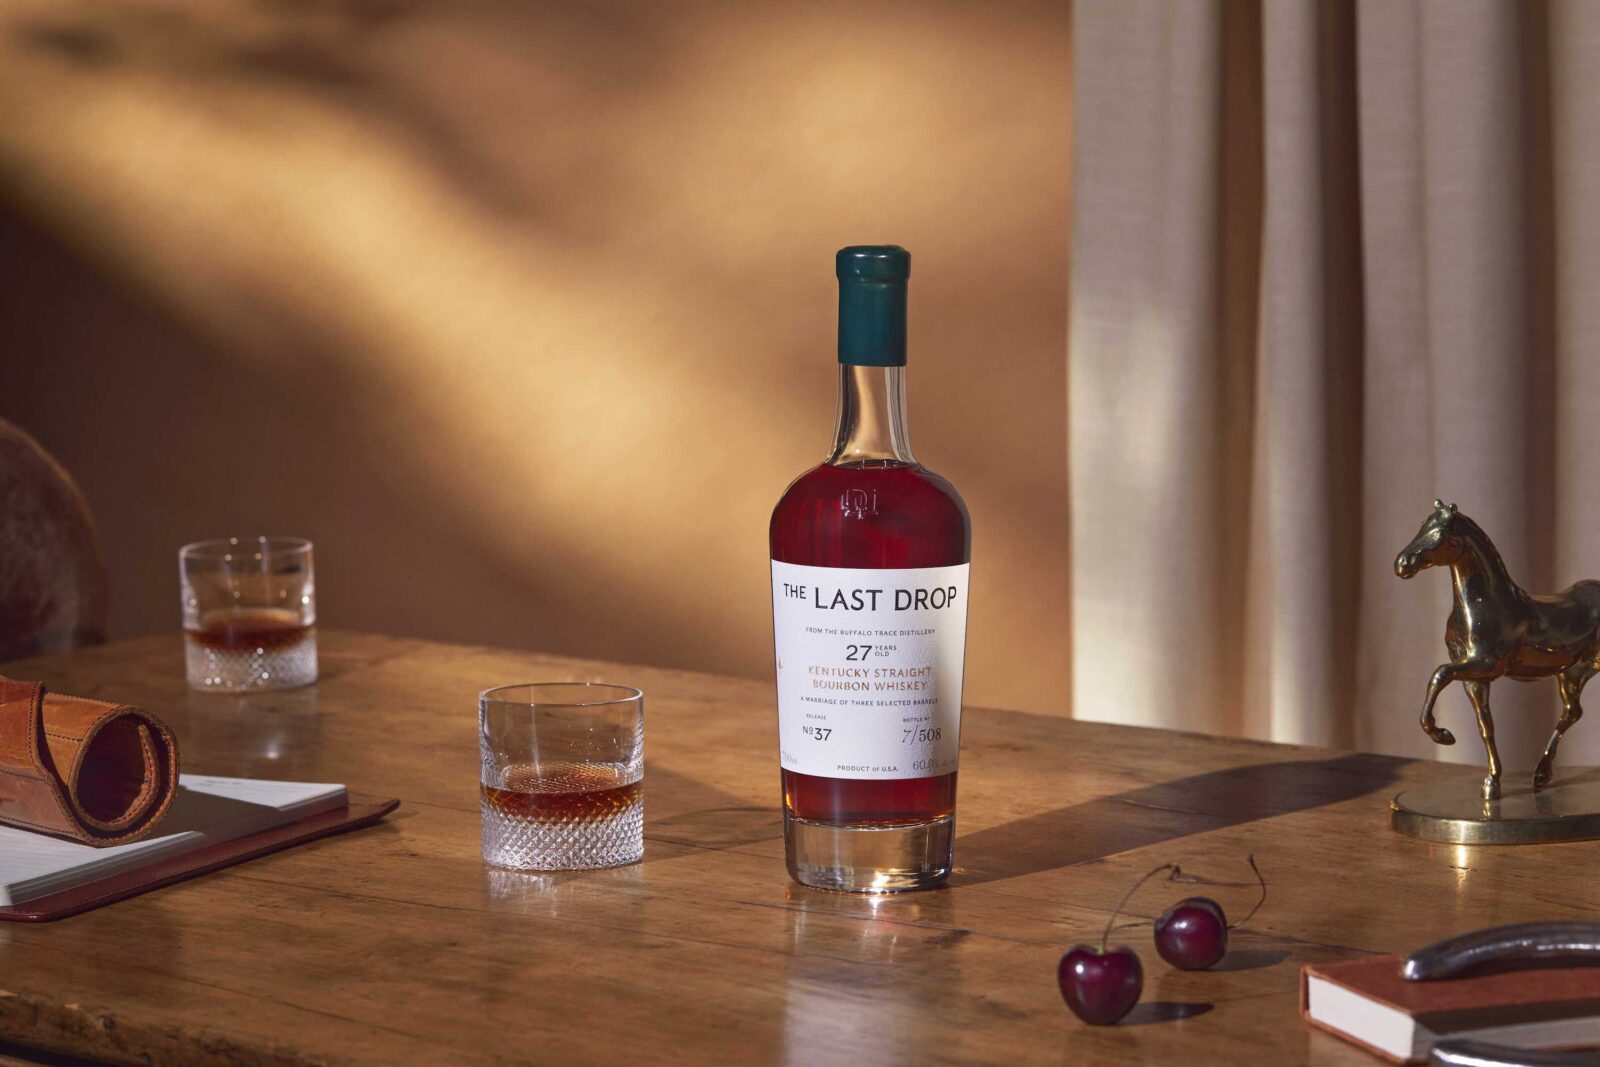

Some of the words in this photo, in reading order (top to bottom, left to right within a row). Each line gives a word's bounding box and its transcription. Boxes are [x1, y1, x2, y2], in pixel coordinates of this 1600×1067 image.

[784, 583, 806, 600] THE
[815, 587, 883, 611] LAST
[894, 586, 957, 611] DROP
[846, 644, 872, 661] 27
[808, 665, 870, 678] KENTUCKY
[874, 666, 932, 678] STRAIGHT
[812, 679, 870, 691] BOURBON
[874, 680, 928, 691] WHISKEY
[806, 696, 836, 705] MARRIAGE
[902, 724, 942, 745] 7/508
